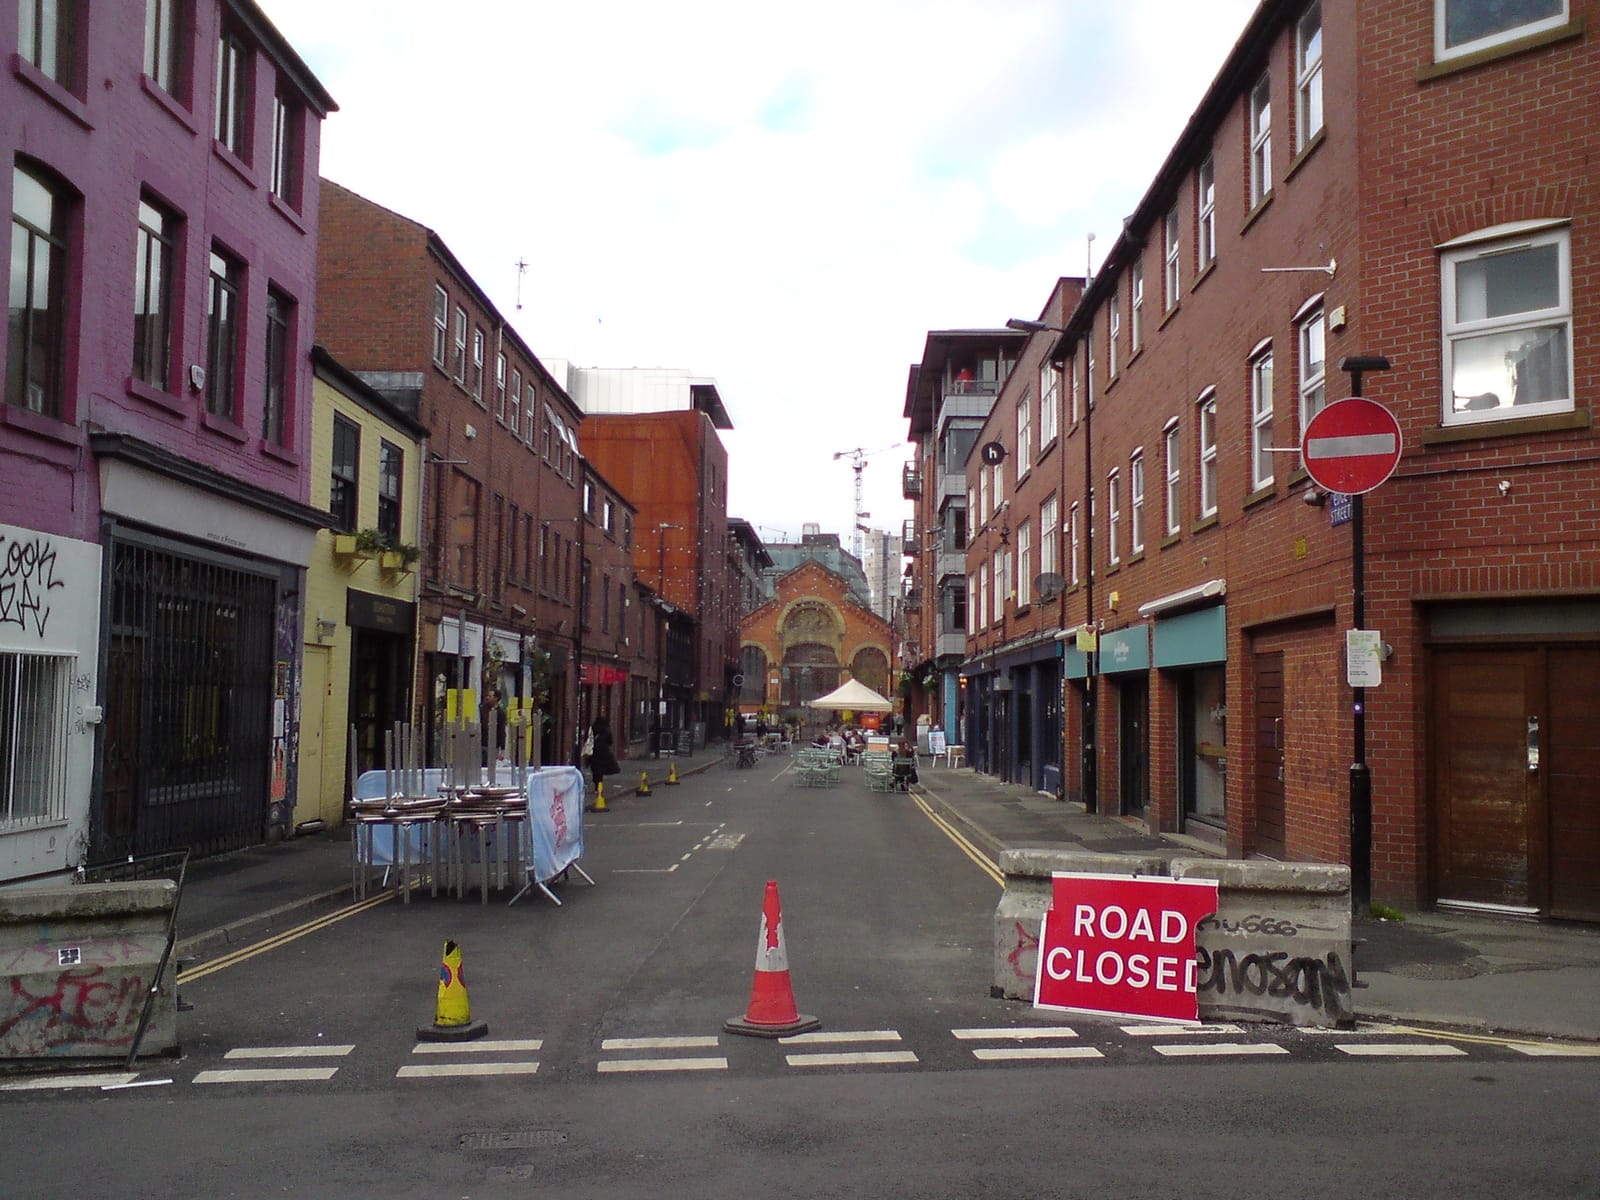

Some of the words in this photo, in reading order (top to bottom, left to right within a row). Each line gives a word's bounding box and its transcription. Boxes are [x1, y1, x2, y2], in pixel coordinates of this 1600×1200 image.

[988, 447, 998, 459] h
[1330, 503, 1351, 523] STREET
[1074, 904, 1188, 944] ROAD
